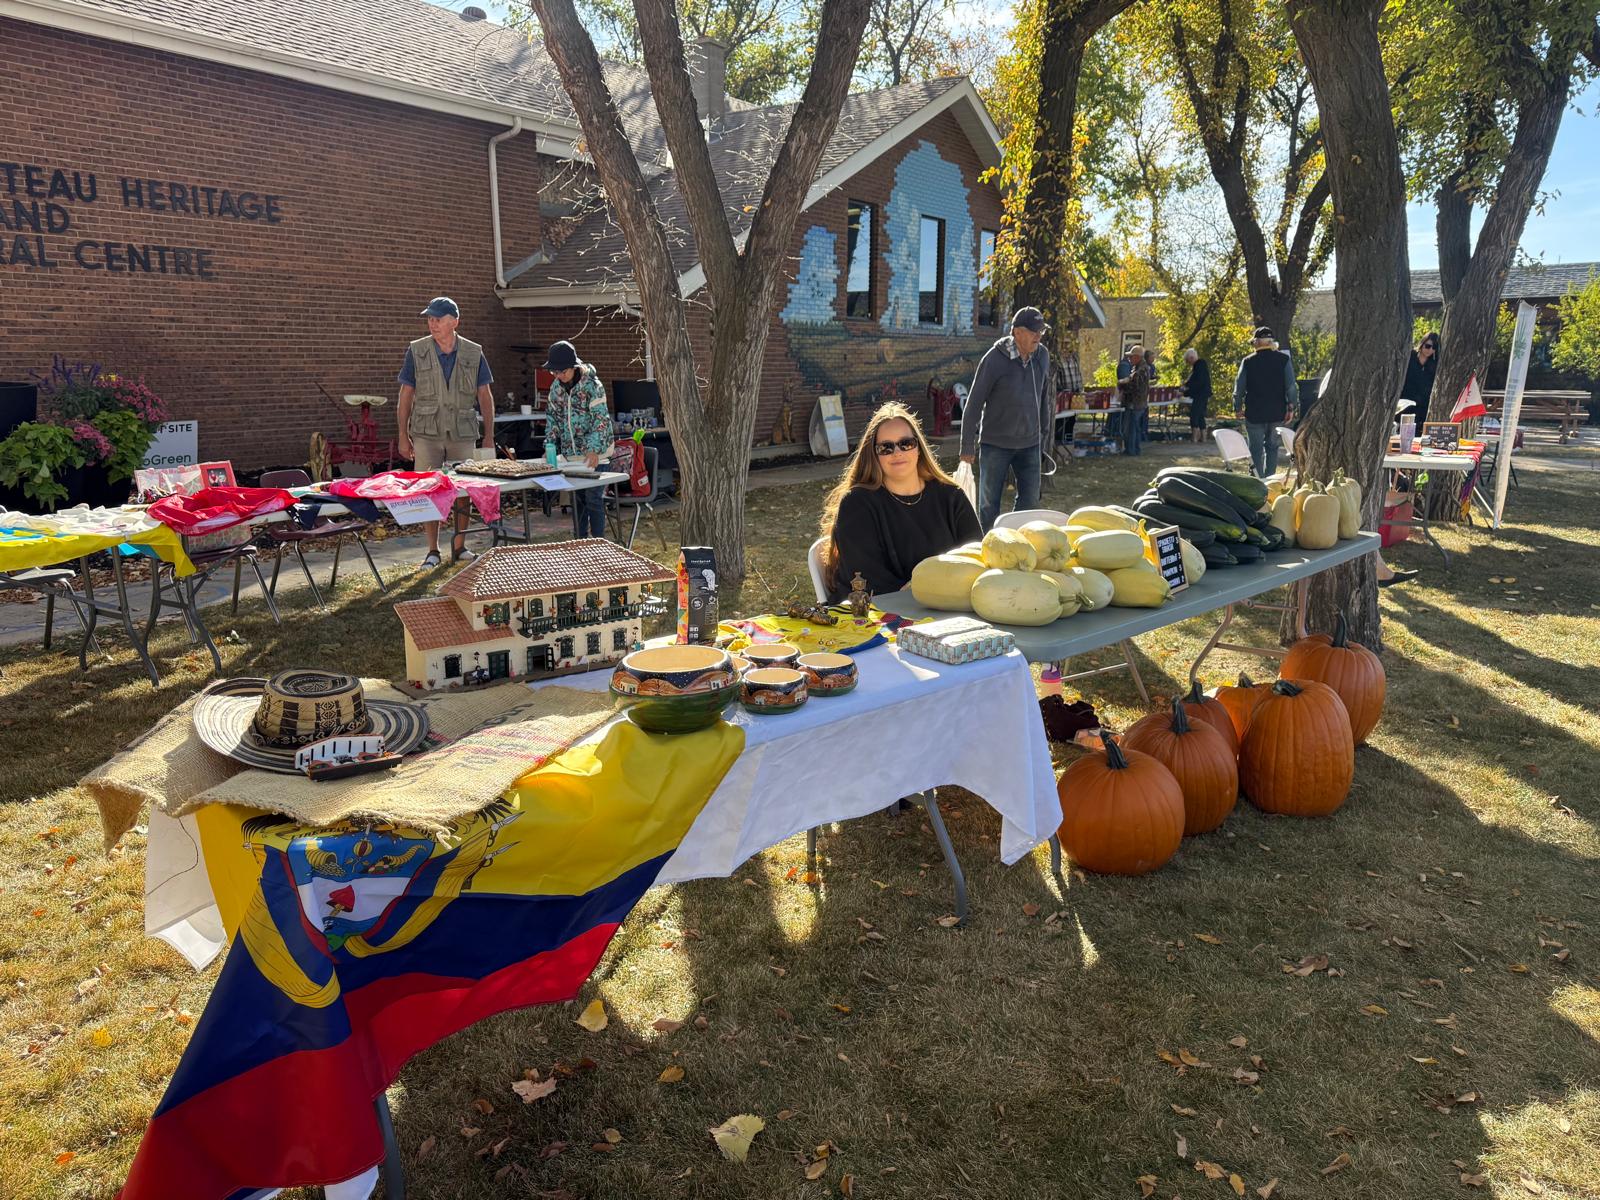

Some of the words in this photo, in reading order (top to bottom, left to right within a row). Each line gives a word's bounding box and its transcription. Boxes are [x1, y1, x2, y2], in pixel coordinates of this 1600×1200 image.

[0, 162, 97, 202] TEAU
[120, 177, 283, 224] HERITAGE
[0, 234, 57, 268] AL
[74, 239, 215, 279] CENTRE
